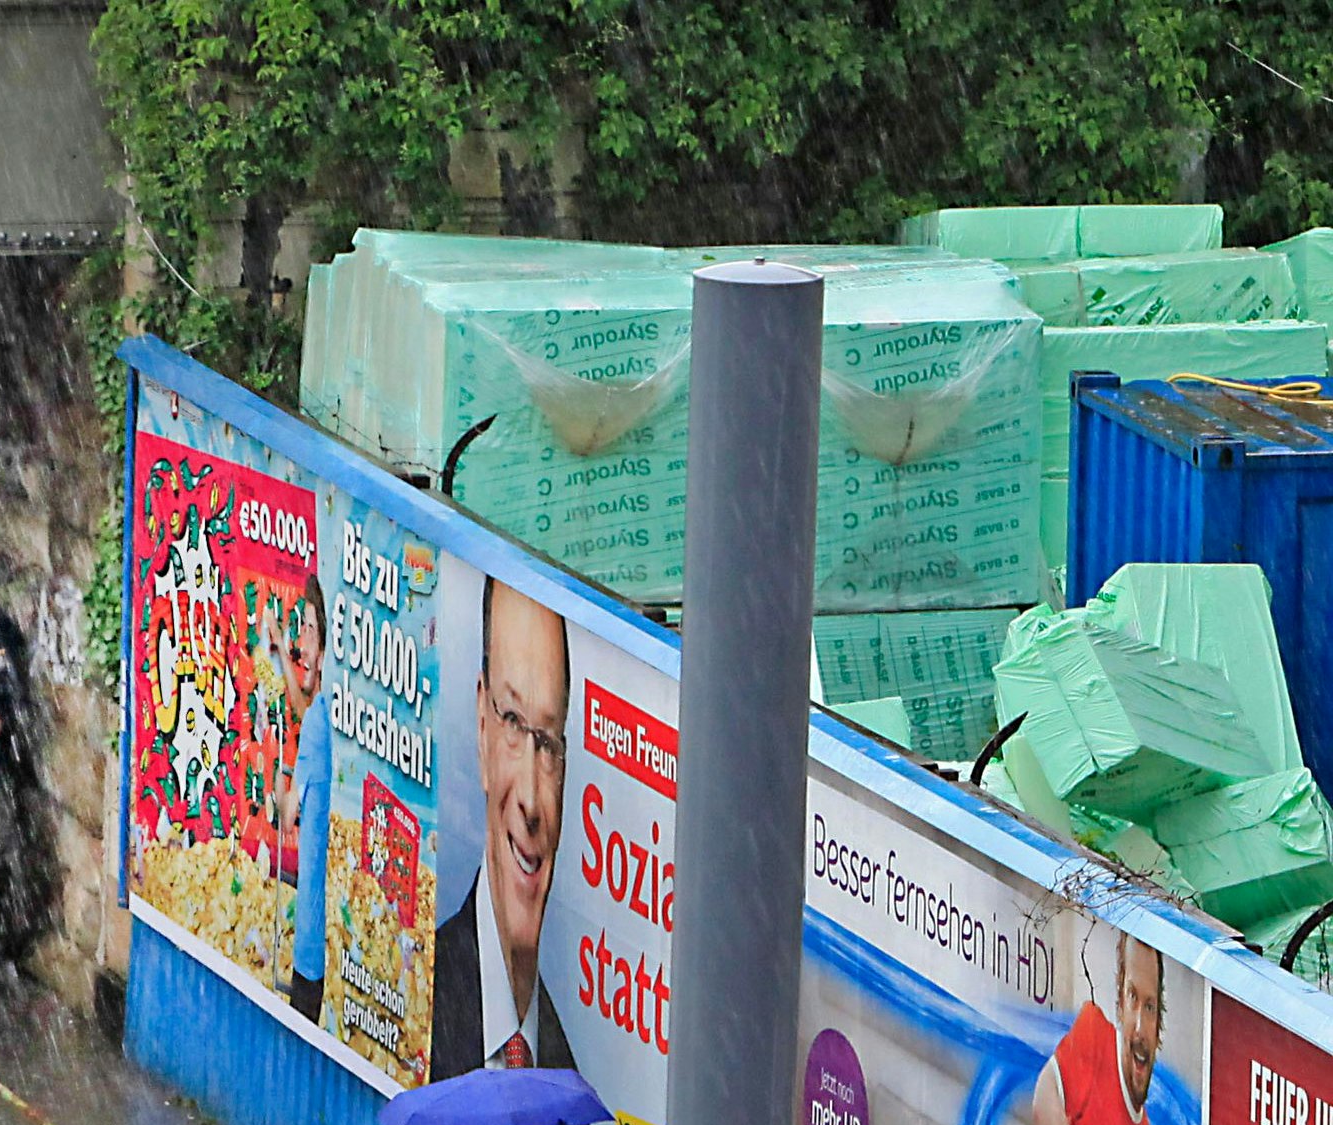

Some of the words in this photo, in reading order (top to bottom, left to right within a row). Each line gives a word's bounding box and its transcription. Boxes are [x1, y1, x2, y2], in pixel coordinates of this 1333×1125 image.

[545, 342, 559, 359] C
[571, 322, 659, 350] Styrodur
[873, 325, 962, 357] Styrodur
[573, 357, 659, 381] Styrodu
[845, 348, 861, 366] C
[874, 361, 960, 391] Styrodur
[564, 458, 651, 486] Styrodur
[845, 477, 859, 495] C
[537, 478, 552, 496] C
[564, 494, 650, 523] Styrodur
[871, 489, 960, 520] Styrodur
[536, 514, 551, 532] C
[843, 512, 859, 530] C
[563, 529, 649, 558] Styrodur
[343, 519, 371, 595] Bis
[375, 554, 399, 612] zu
[332, 669, 432, 788] abcashen!
[590, 698, 632, 759] Eugen
[636, 723, 677, 783] Freun
[581, 783, 675, 933] Sozia
[813, 813, 881, 907] Besser
[886, 850, 984, 970] fernsehen
[991, 912, 1009, 985] in
[1017, 927, 1054, 1012] HD!
[341, 949, 372, 994] Heute
[374, 978, 405, 1018] schon
[579, 926, 670, 1056] statt
[343, 996, 399, 1053] gerubbelt?
